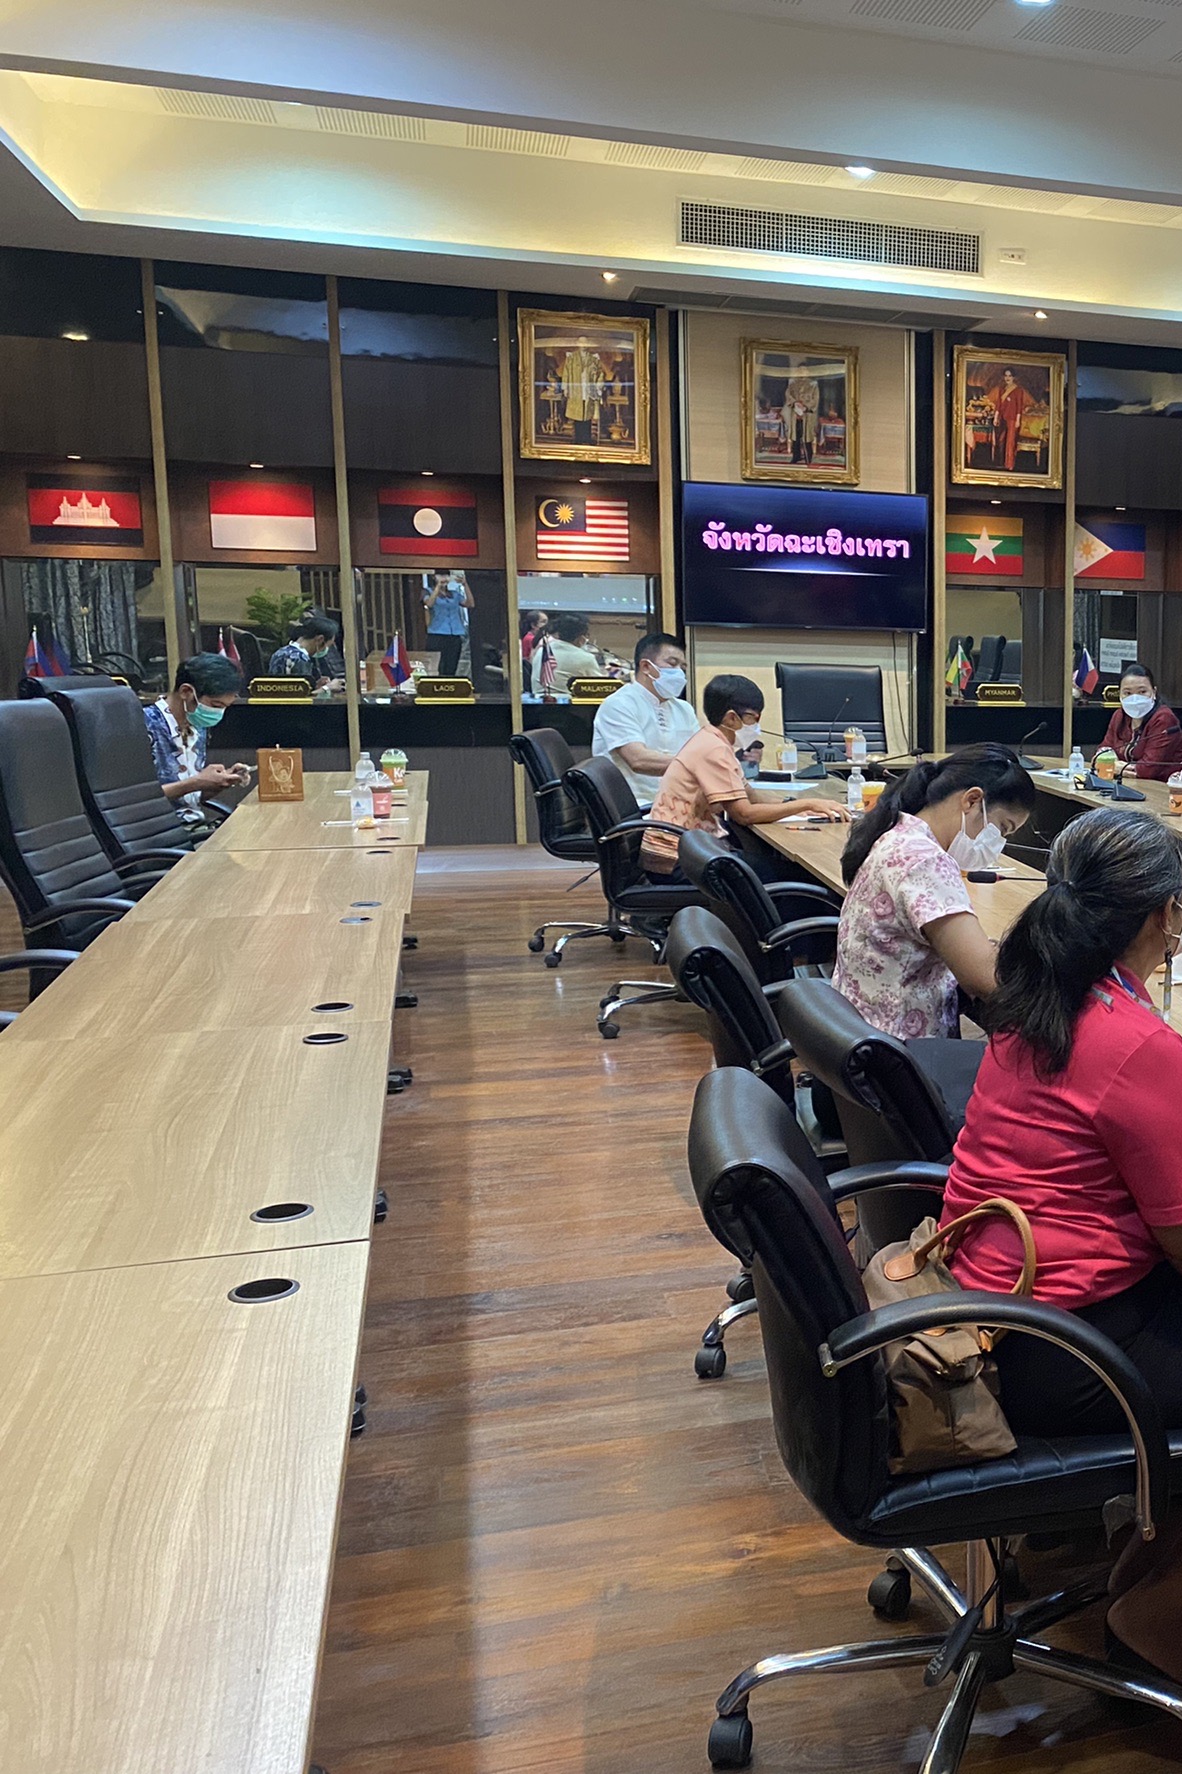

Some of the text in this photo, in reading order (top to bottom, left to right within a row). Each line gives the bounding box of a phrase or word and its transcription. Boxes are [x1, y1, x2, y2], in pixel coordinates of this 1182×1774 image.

[702, 520, 910, 559] จังหวัดฉะเชิงเทรา
[256, 684, 304, 692] INDONESIA
[433, 684, 456, 692] LAOS
[580, 685, 617, 693] MALAYSIA
